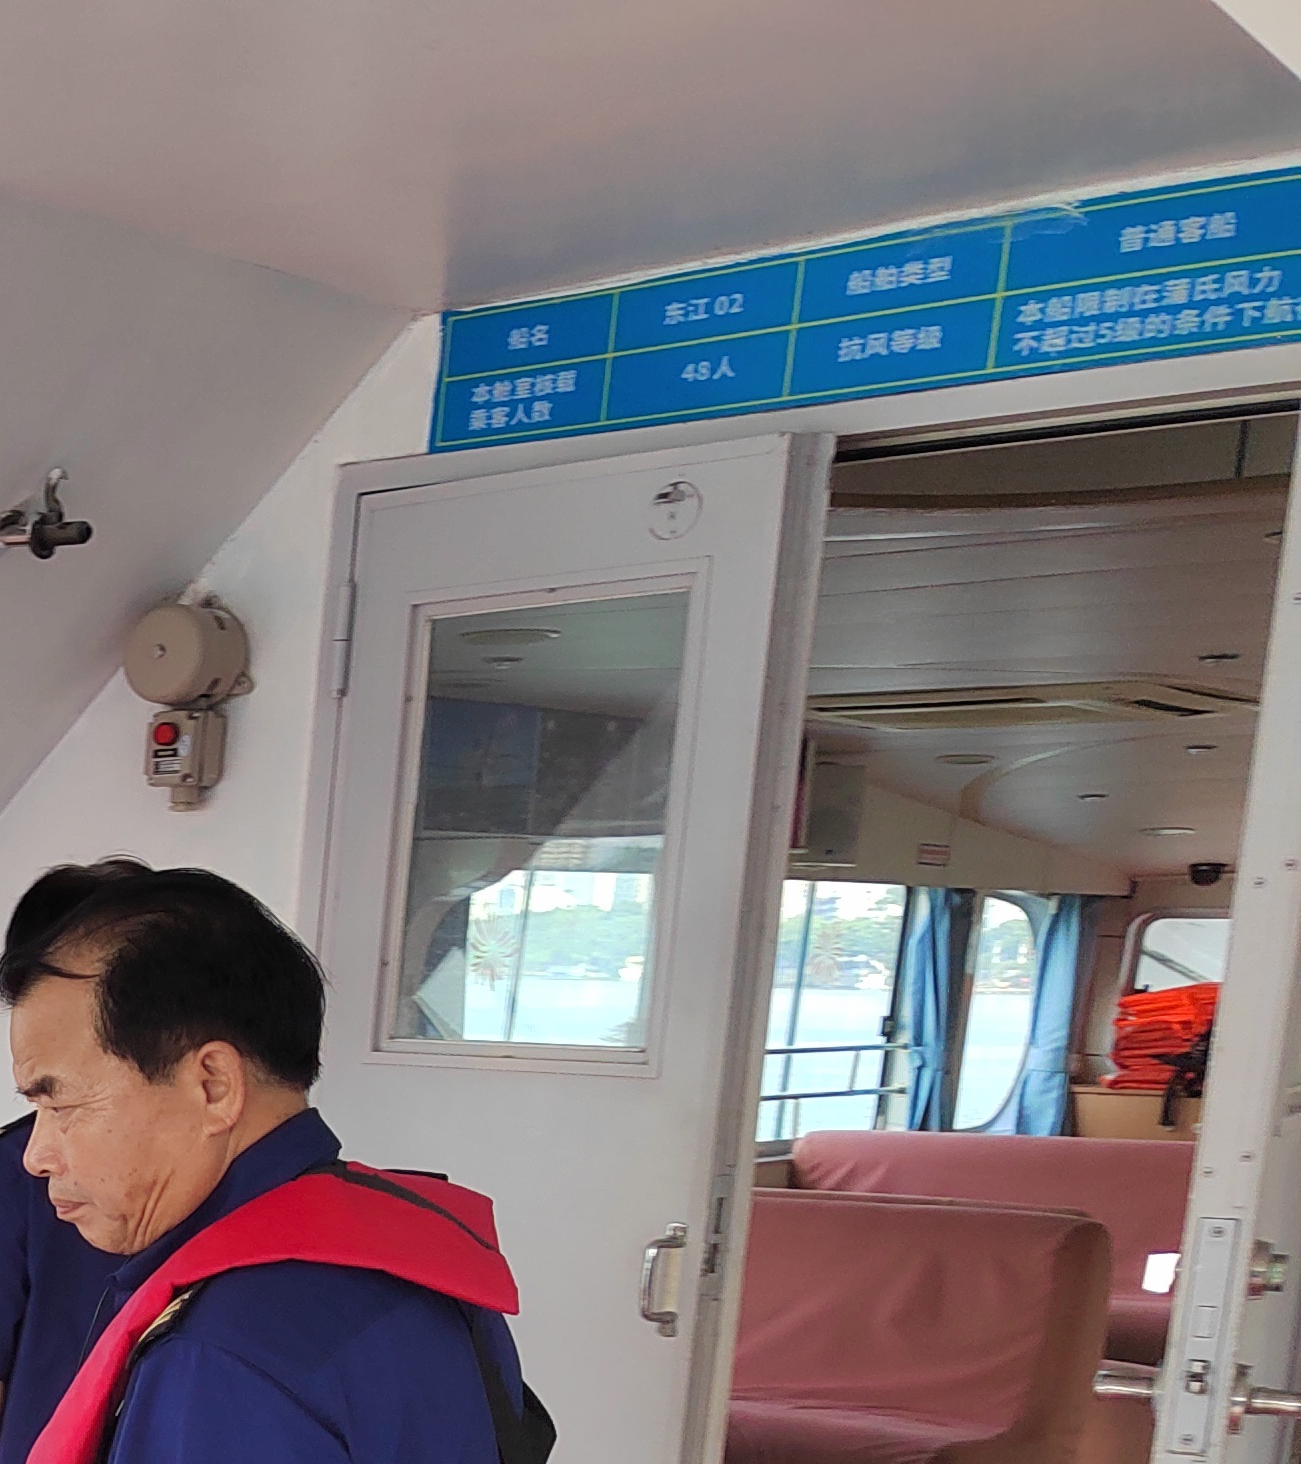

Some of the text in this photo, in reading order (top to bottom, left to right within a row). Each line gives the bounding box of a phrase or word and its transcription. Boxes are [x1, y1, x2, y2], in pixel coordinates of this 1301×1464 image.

[1118, 211, 1238, 253] 普通客船
[845, 256, 954, 296] 船舶类型
[507, 324, 550, 350] 船名
[837, 326, 944, 363] 抗风等级
[680, 355, 736, 382] 48人
[468, 400, 553, 431] 乘客人数
